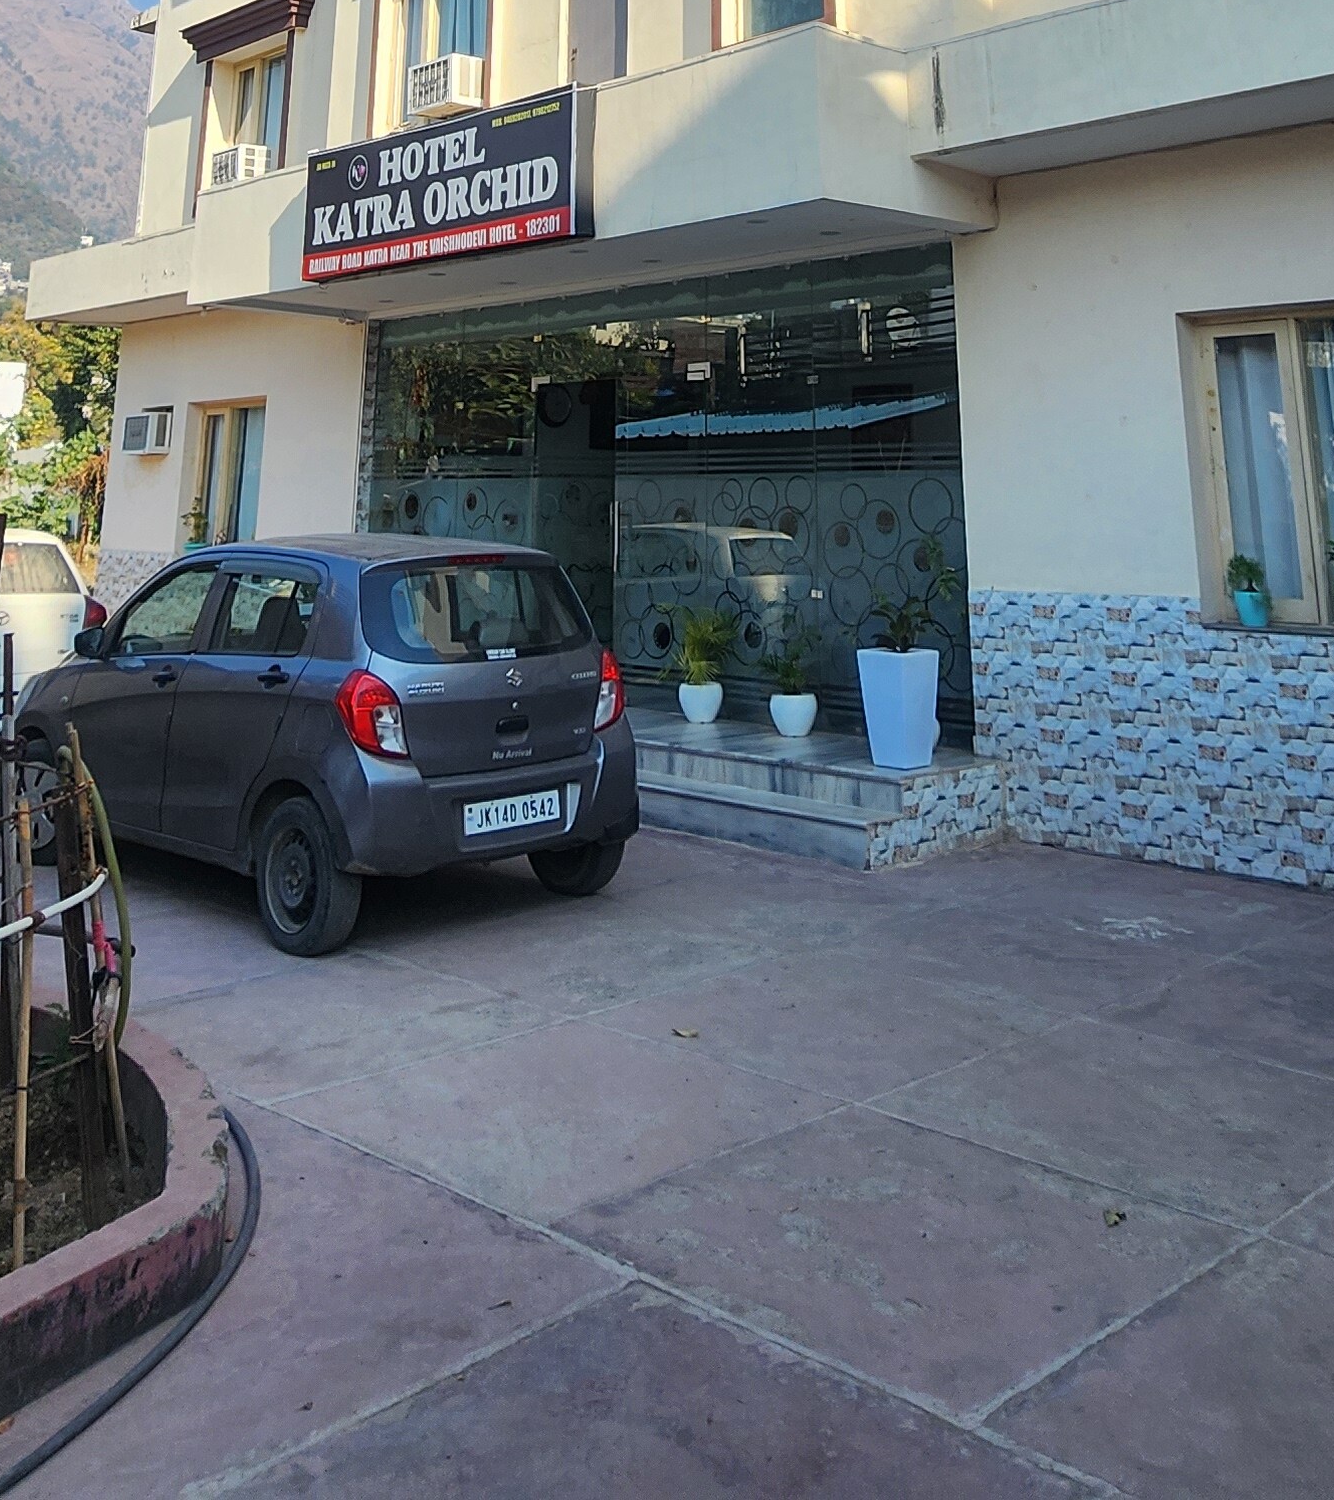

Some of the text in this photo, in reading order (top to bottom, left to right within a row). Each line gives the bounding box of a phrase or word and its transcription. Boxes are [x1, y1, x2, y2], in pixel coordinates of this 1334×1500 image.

[378, 126, 485, 187] HOTEL
[312, 156, 558, 245] KATRA ORCHID
[309, 255, 341, 274] RAILWAY
[341, 251, 362, 270] ROAD
[363, 247, 388, 266] KATRA
[390, 243, 410, 262] NEAR
[412, 239, 428, 257] THE
[430, 228, 487, 255] VAISHNODEVI
[489, 223, 517, 244] HOTEL
[525, 214, 561, 237] 182301
[477, 798, 555, 828] JK14D 0542
